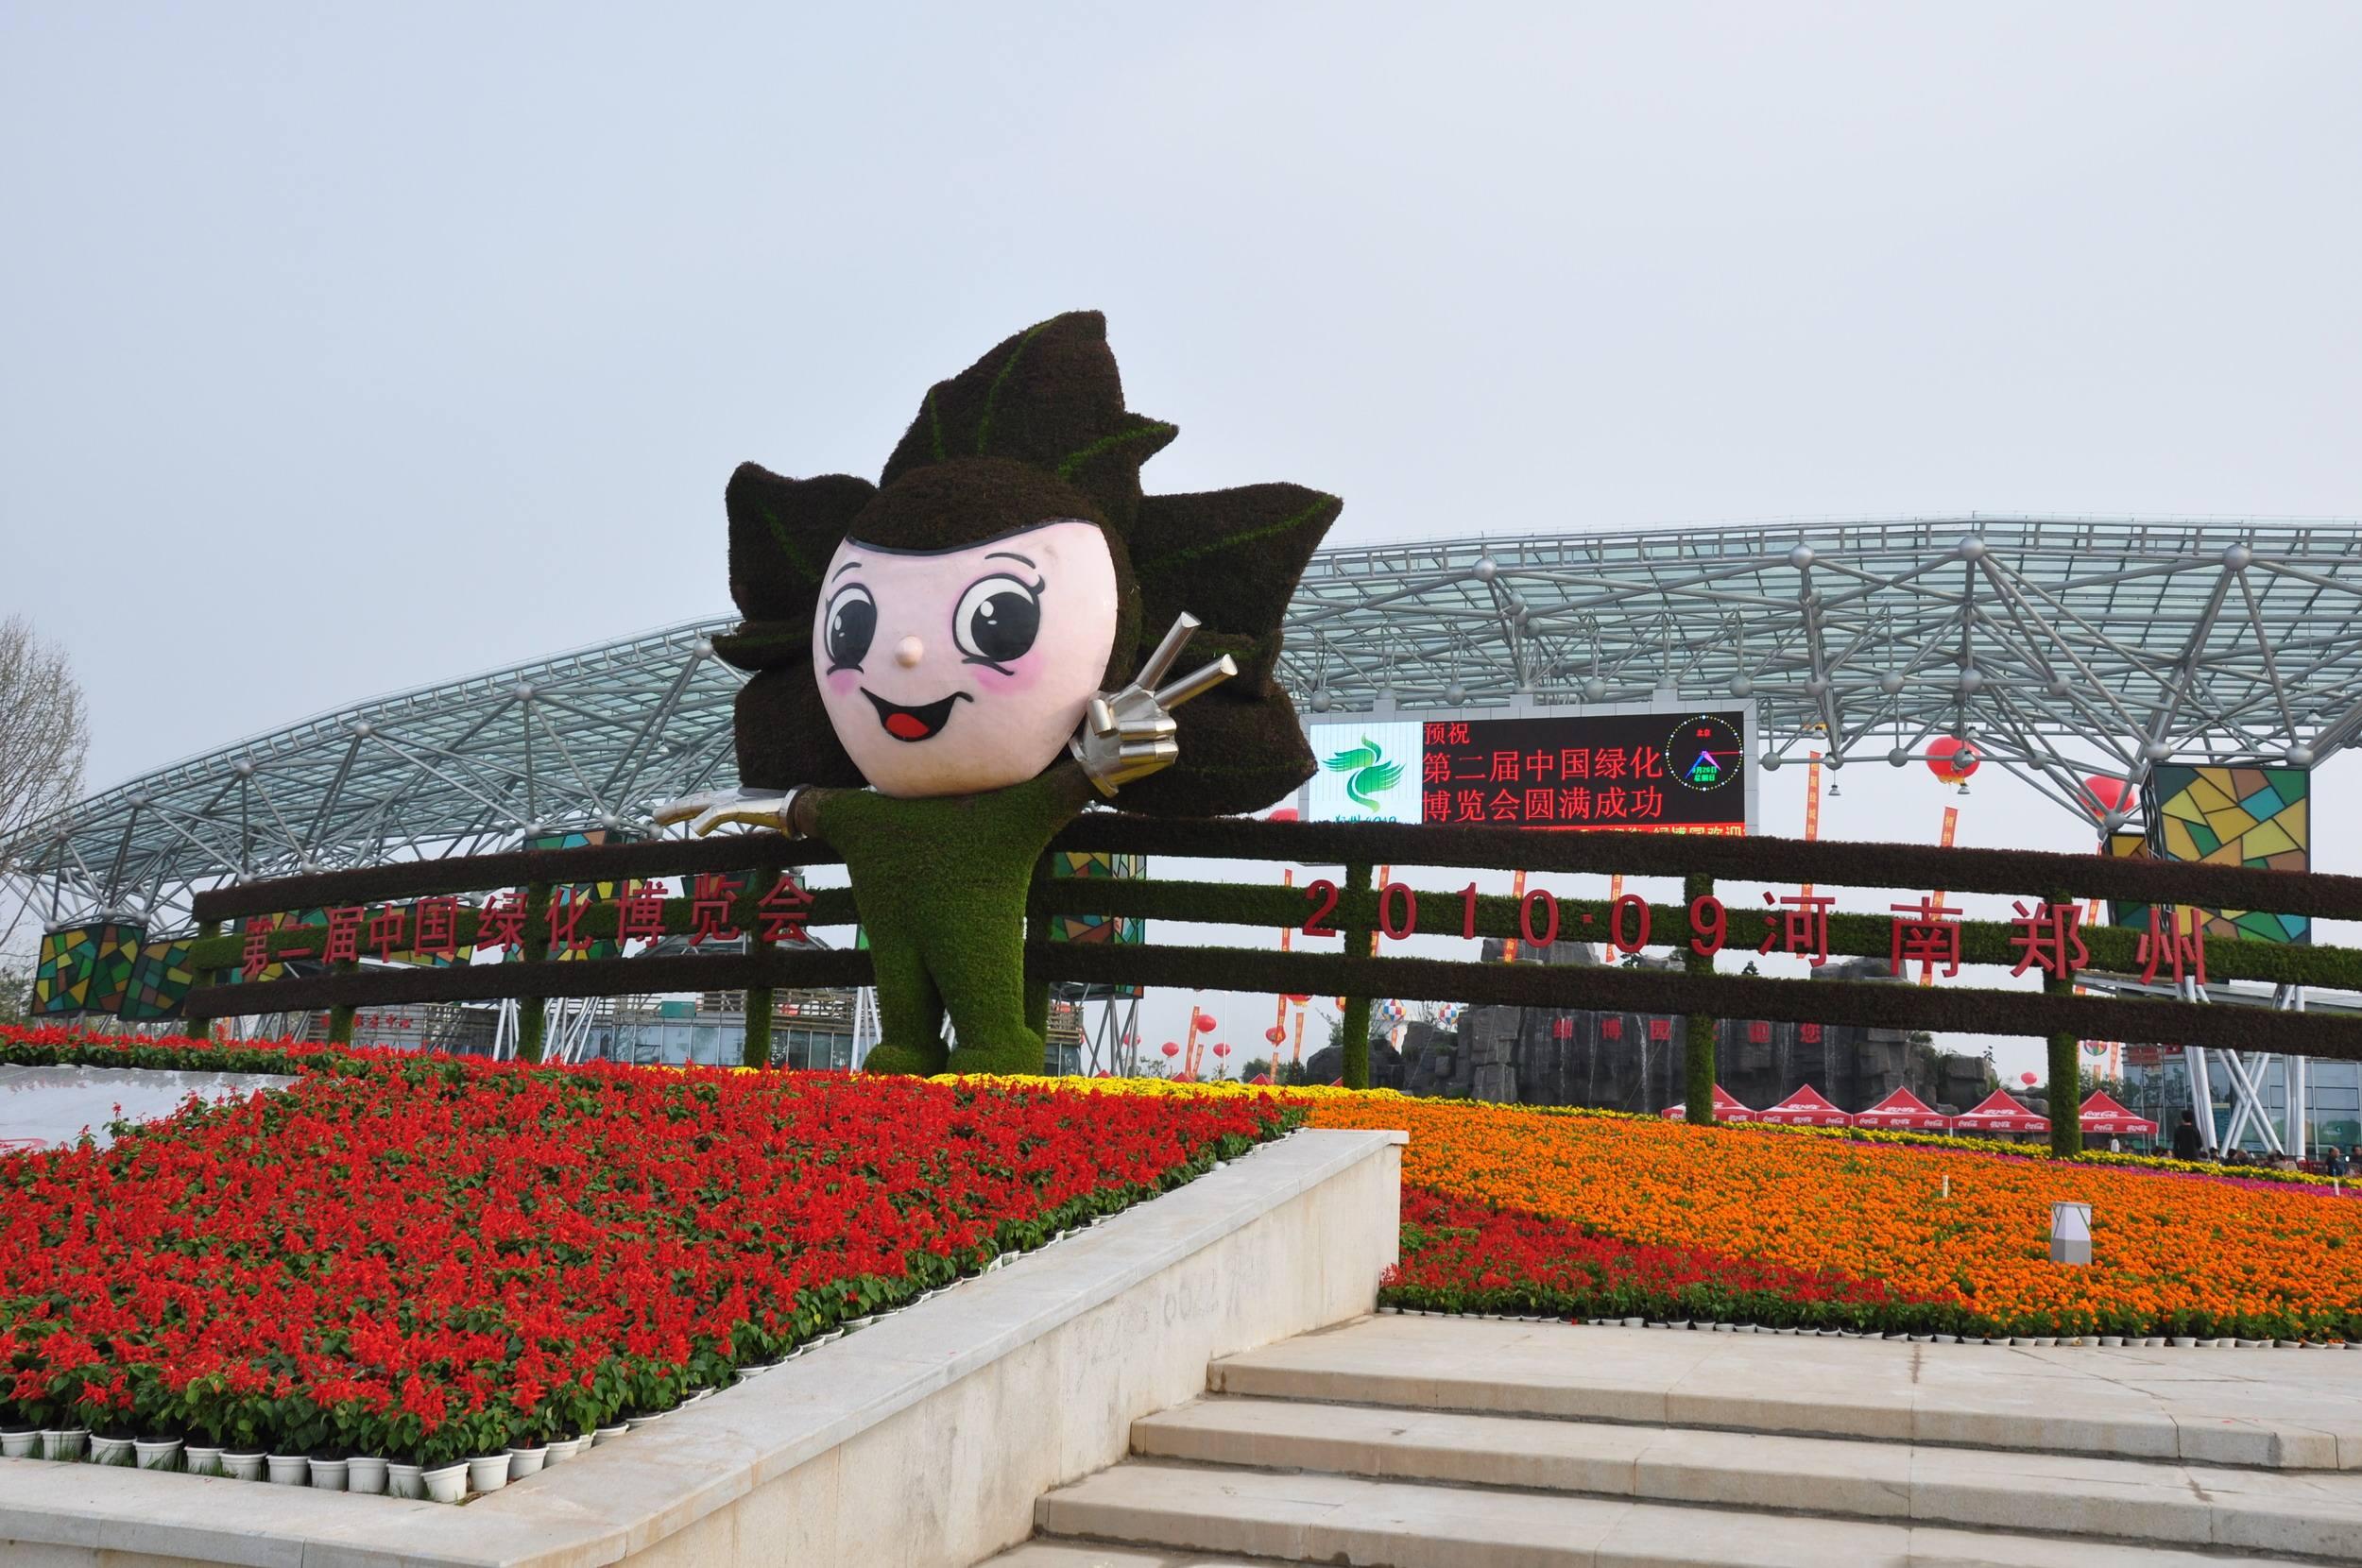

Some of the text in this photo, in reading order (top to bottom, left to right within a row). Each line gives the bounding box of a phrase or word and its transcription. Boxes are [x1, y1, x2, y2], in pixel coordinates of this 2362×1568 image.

[1424, 723, 1470, 744] 预祝
[1423, 745, 1664, 784] 第二届中国绿化
[1422, 787, 1664, 823] 博览会圆满成功
[241, 874, 815, 977] 第二届中国绿化博览会
